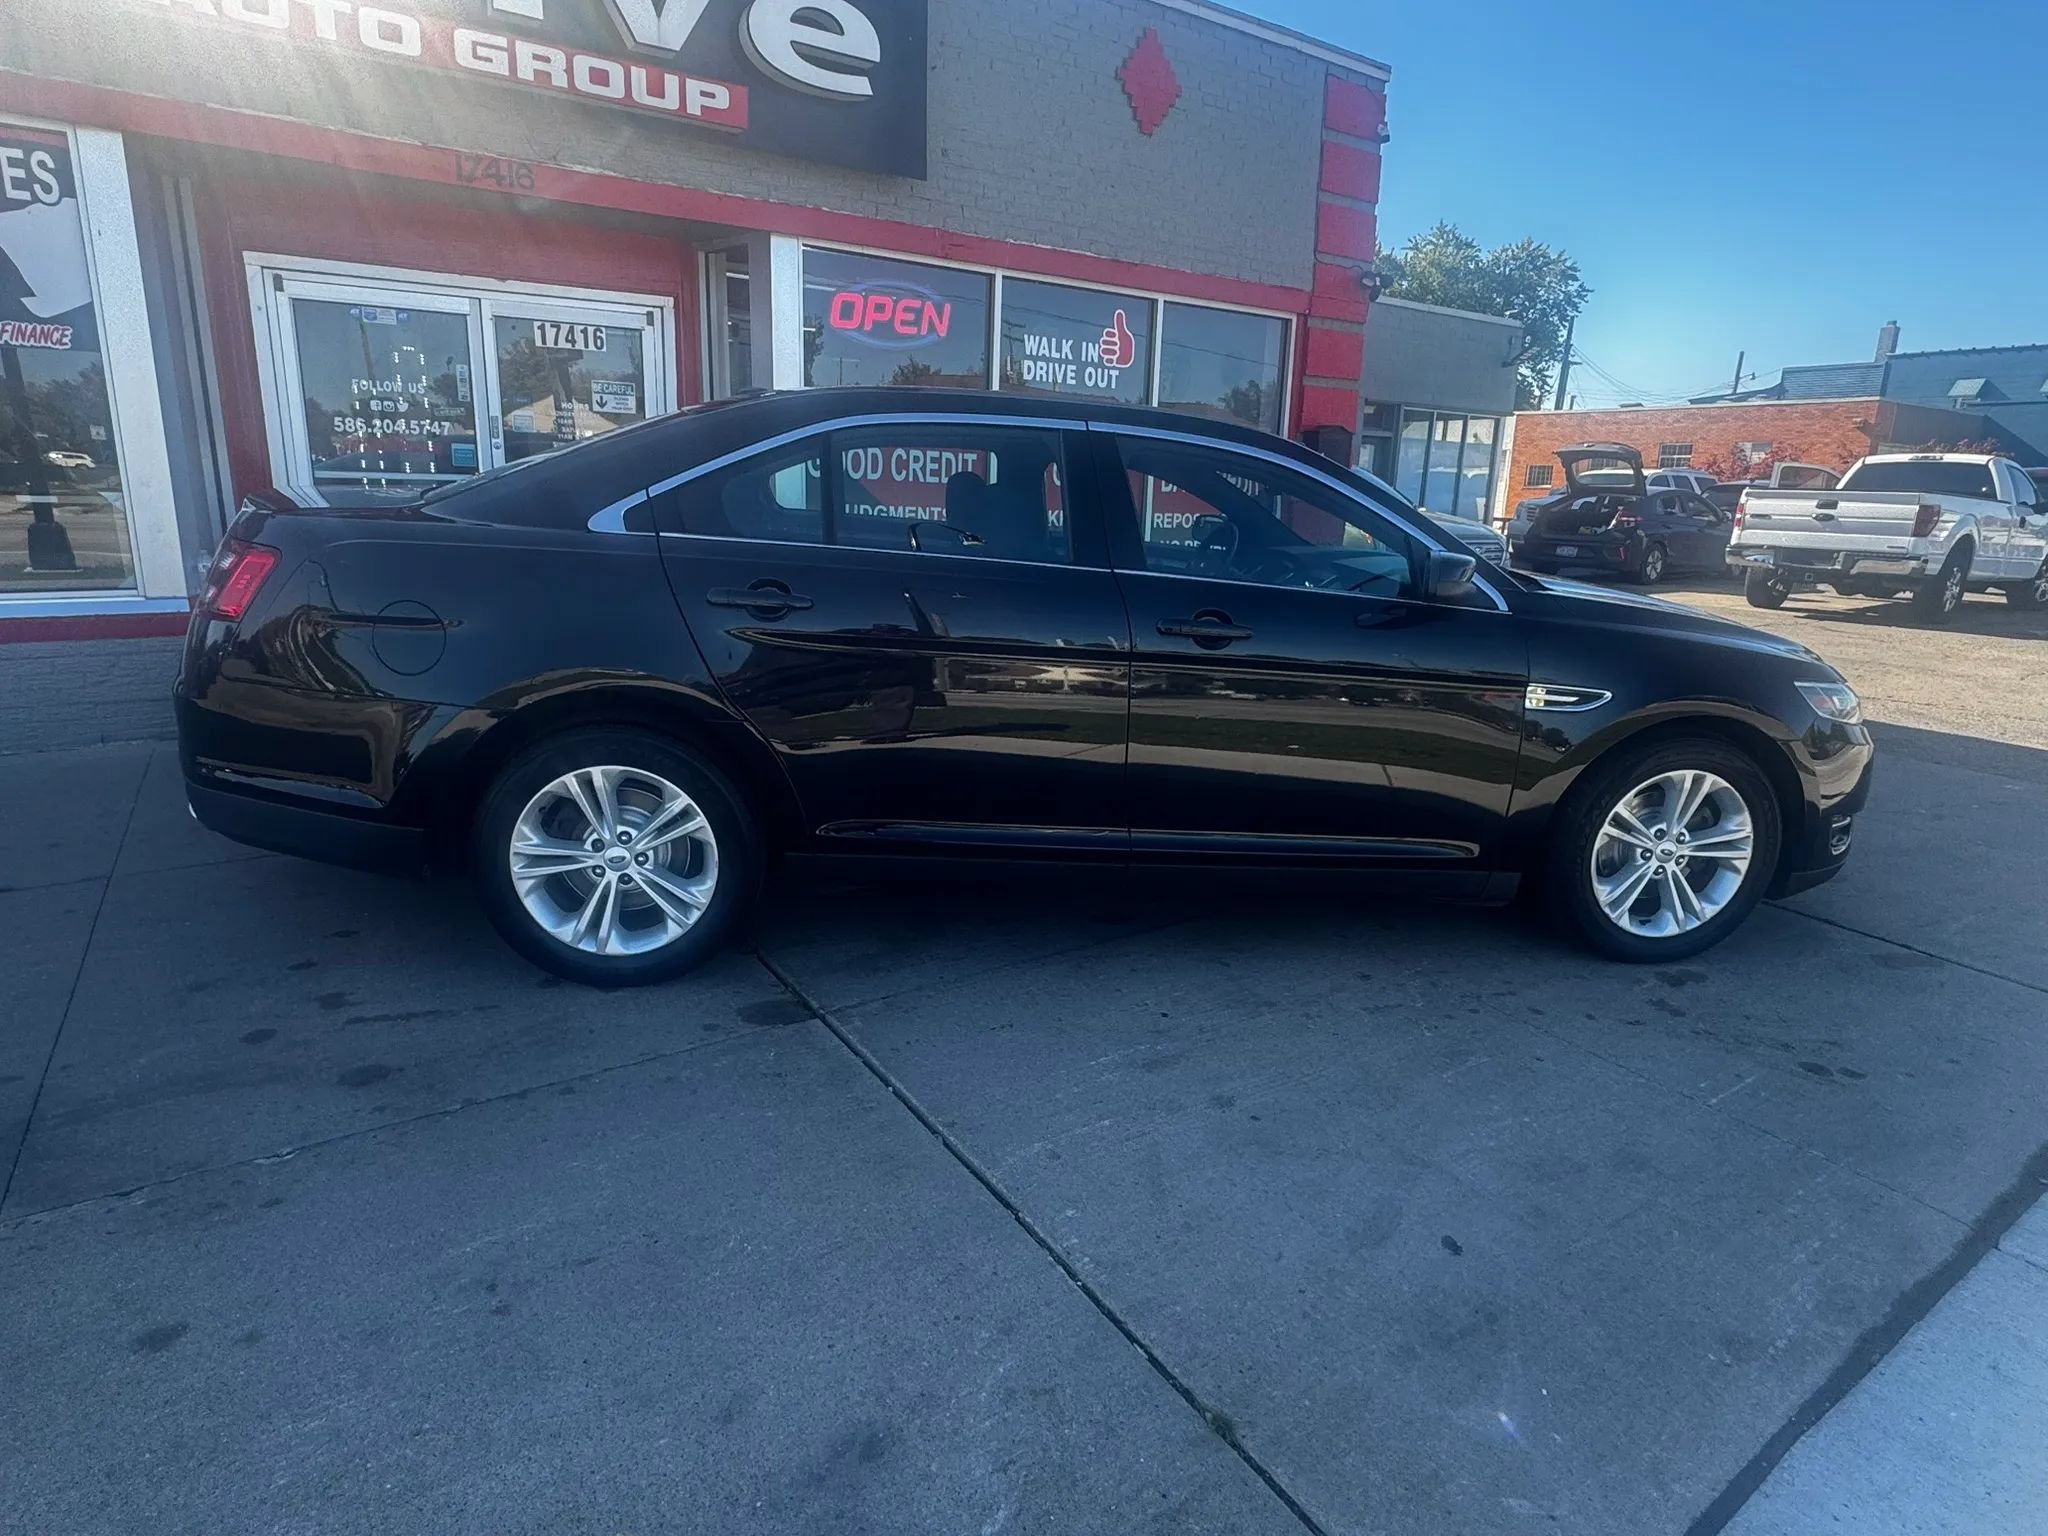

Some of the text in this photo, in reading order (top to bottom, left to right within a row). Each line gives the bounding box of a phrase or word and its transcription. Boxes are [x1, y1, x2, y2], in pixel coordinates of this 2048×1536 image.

[453, 27, 730, 115] GROUP
[456, 153, 535, 190] 17416
[829, 292, 952, 338] OPEN
[0, 321, 73, 348] FINANCE
[536, 321, 605, 350] 17416
[1023, 333, 1099, 363] WALK IN
[351, 378, 426, 395] FOLLOW US
[603, 383, 634, 395] CAREFUL
[1022, 359, 1120, 390] DRIVE OUT
[333, 416, 450, 436] 586.204.5747
